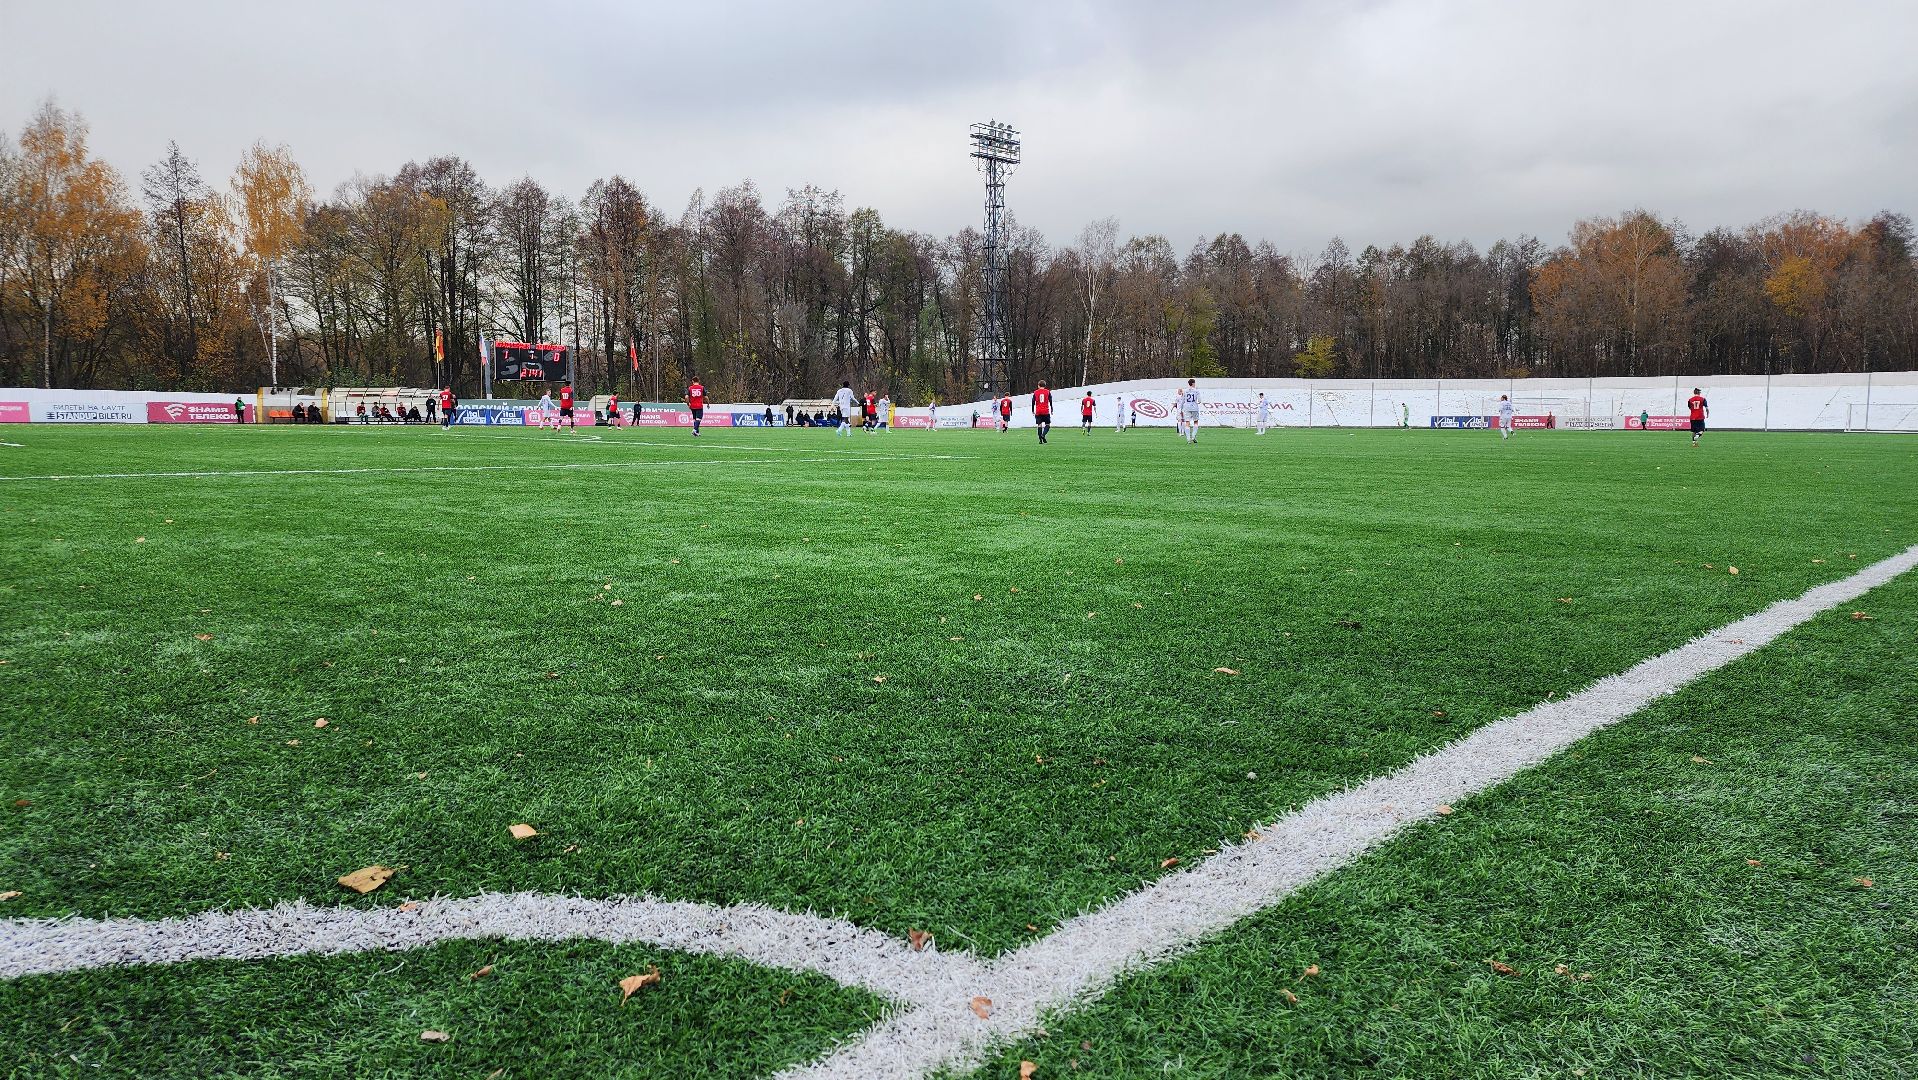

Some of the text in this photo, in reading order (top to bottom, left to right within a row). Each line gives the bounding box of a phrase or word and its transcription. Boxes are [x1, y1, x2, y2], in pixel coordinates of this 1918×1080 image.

[1186, 393, 1196, 403] 21
[1692, 400, 1701, 410] 17
[188, 413, 238, 421] ТЕЛЕКОМ
